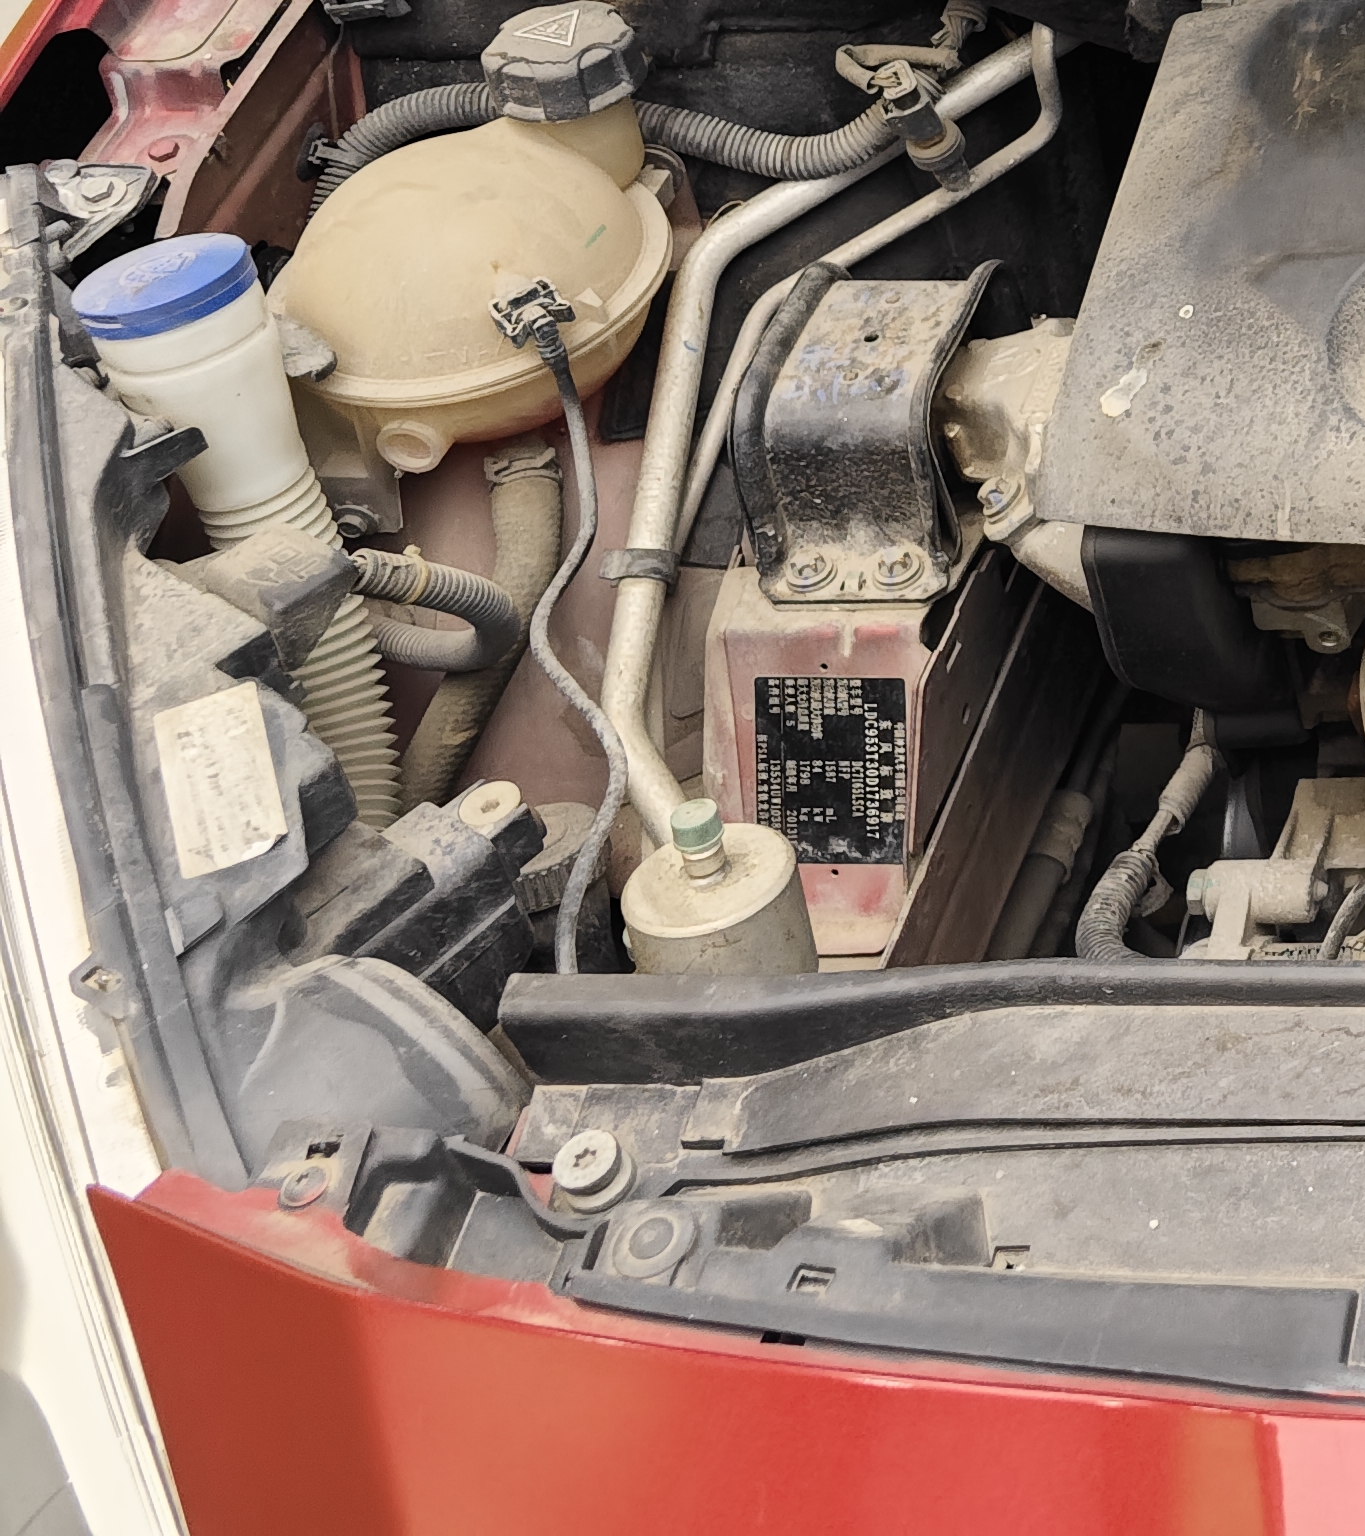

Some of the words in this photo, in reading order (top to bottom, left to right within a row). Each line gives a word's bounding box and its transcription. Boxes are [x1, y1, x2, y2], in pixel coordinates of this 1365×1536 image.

[770, 759, 782, 834] 13534UW1038
[800, 760, 811, 785] 1798
[865, 703, 880, 839] LDC953T30D1736917
